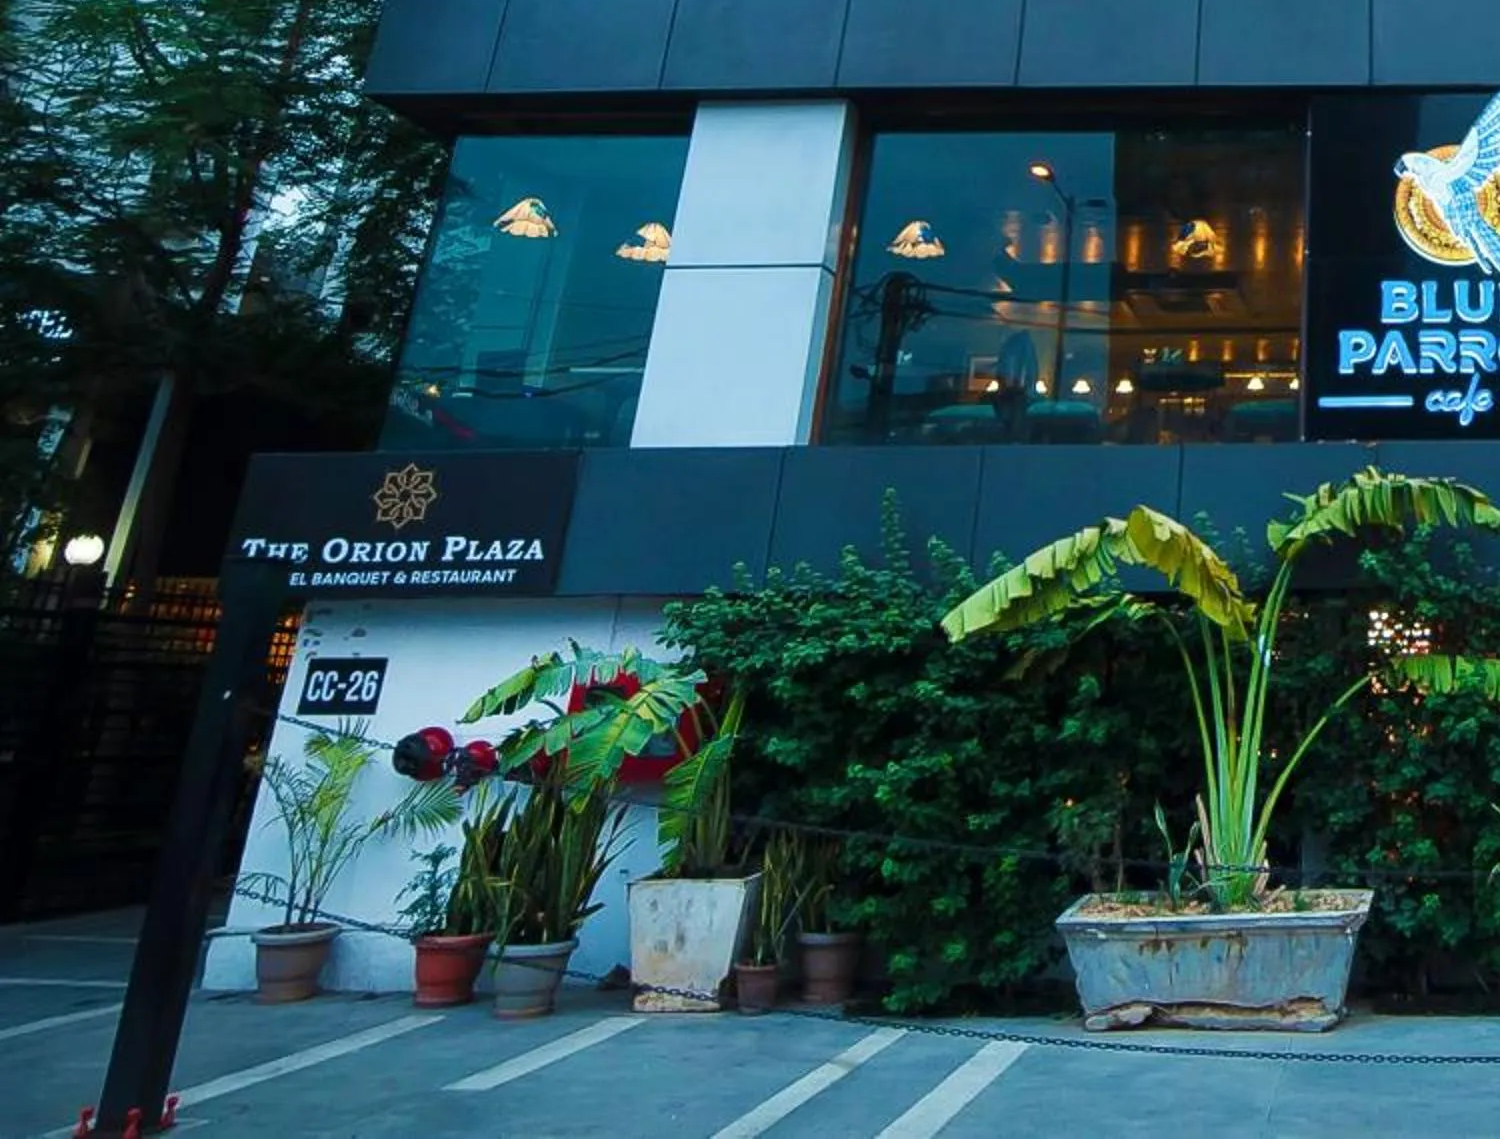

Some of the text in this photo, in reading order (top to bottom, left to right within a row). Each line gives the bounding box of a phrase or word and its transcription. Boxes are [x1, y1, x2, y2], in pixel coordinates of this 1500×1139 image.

[242, 536, 544, 563] THE ORION PLAZA
[311, 570, 391, 586] BANQUET
[393, 570, 407, 584] &
[410, 568, 517, 584] RESTAURANT
[306, 670, 379, 702] CC-26
